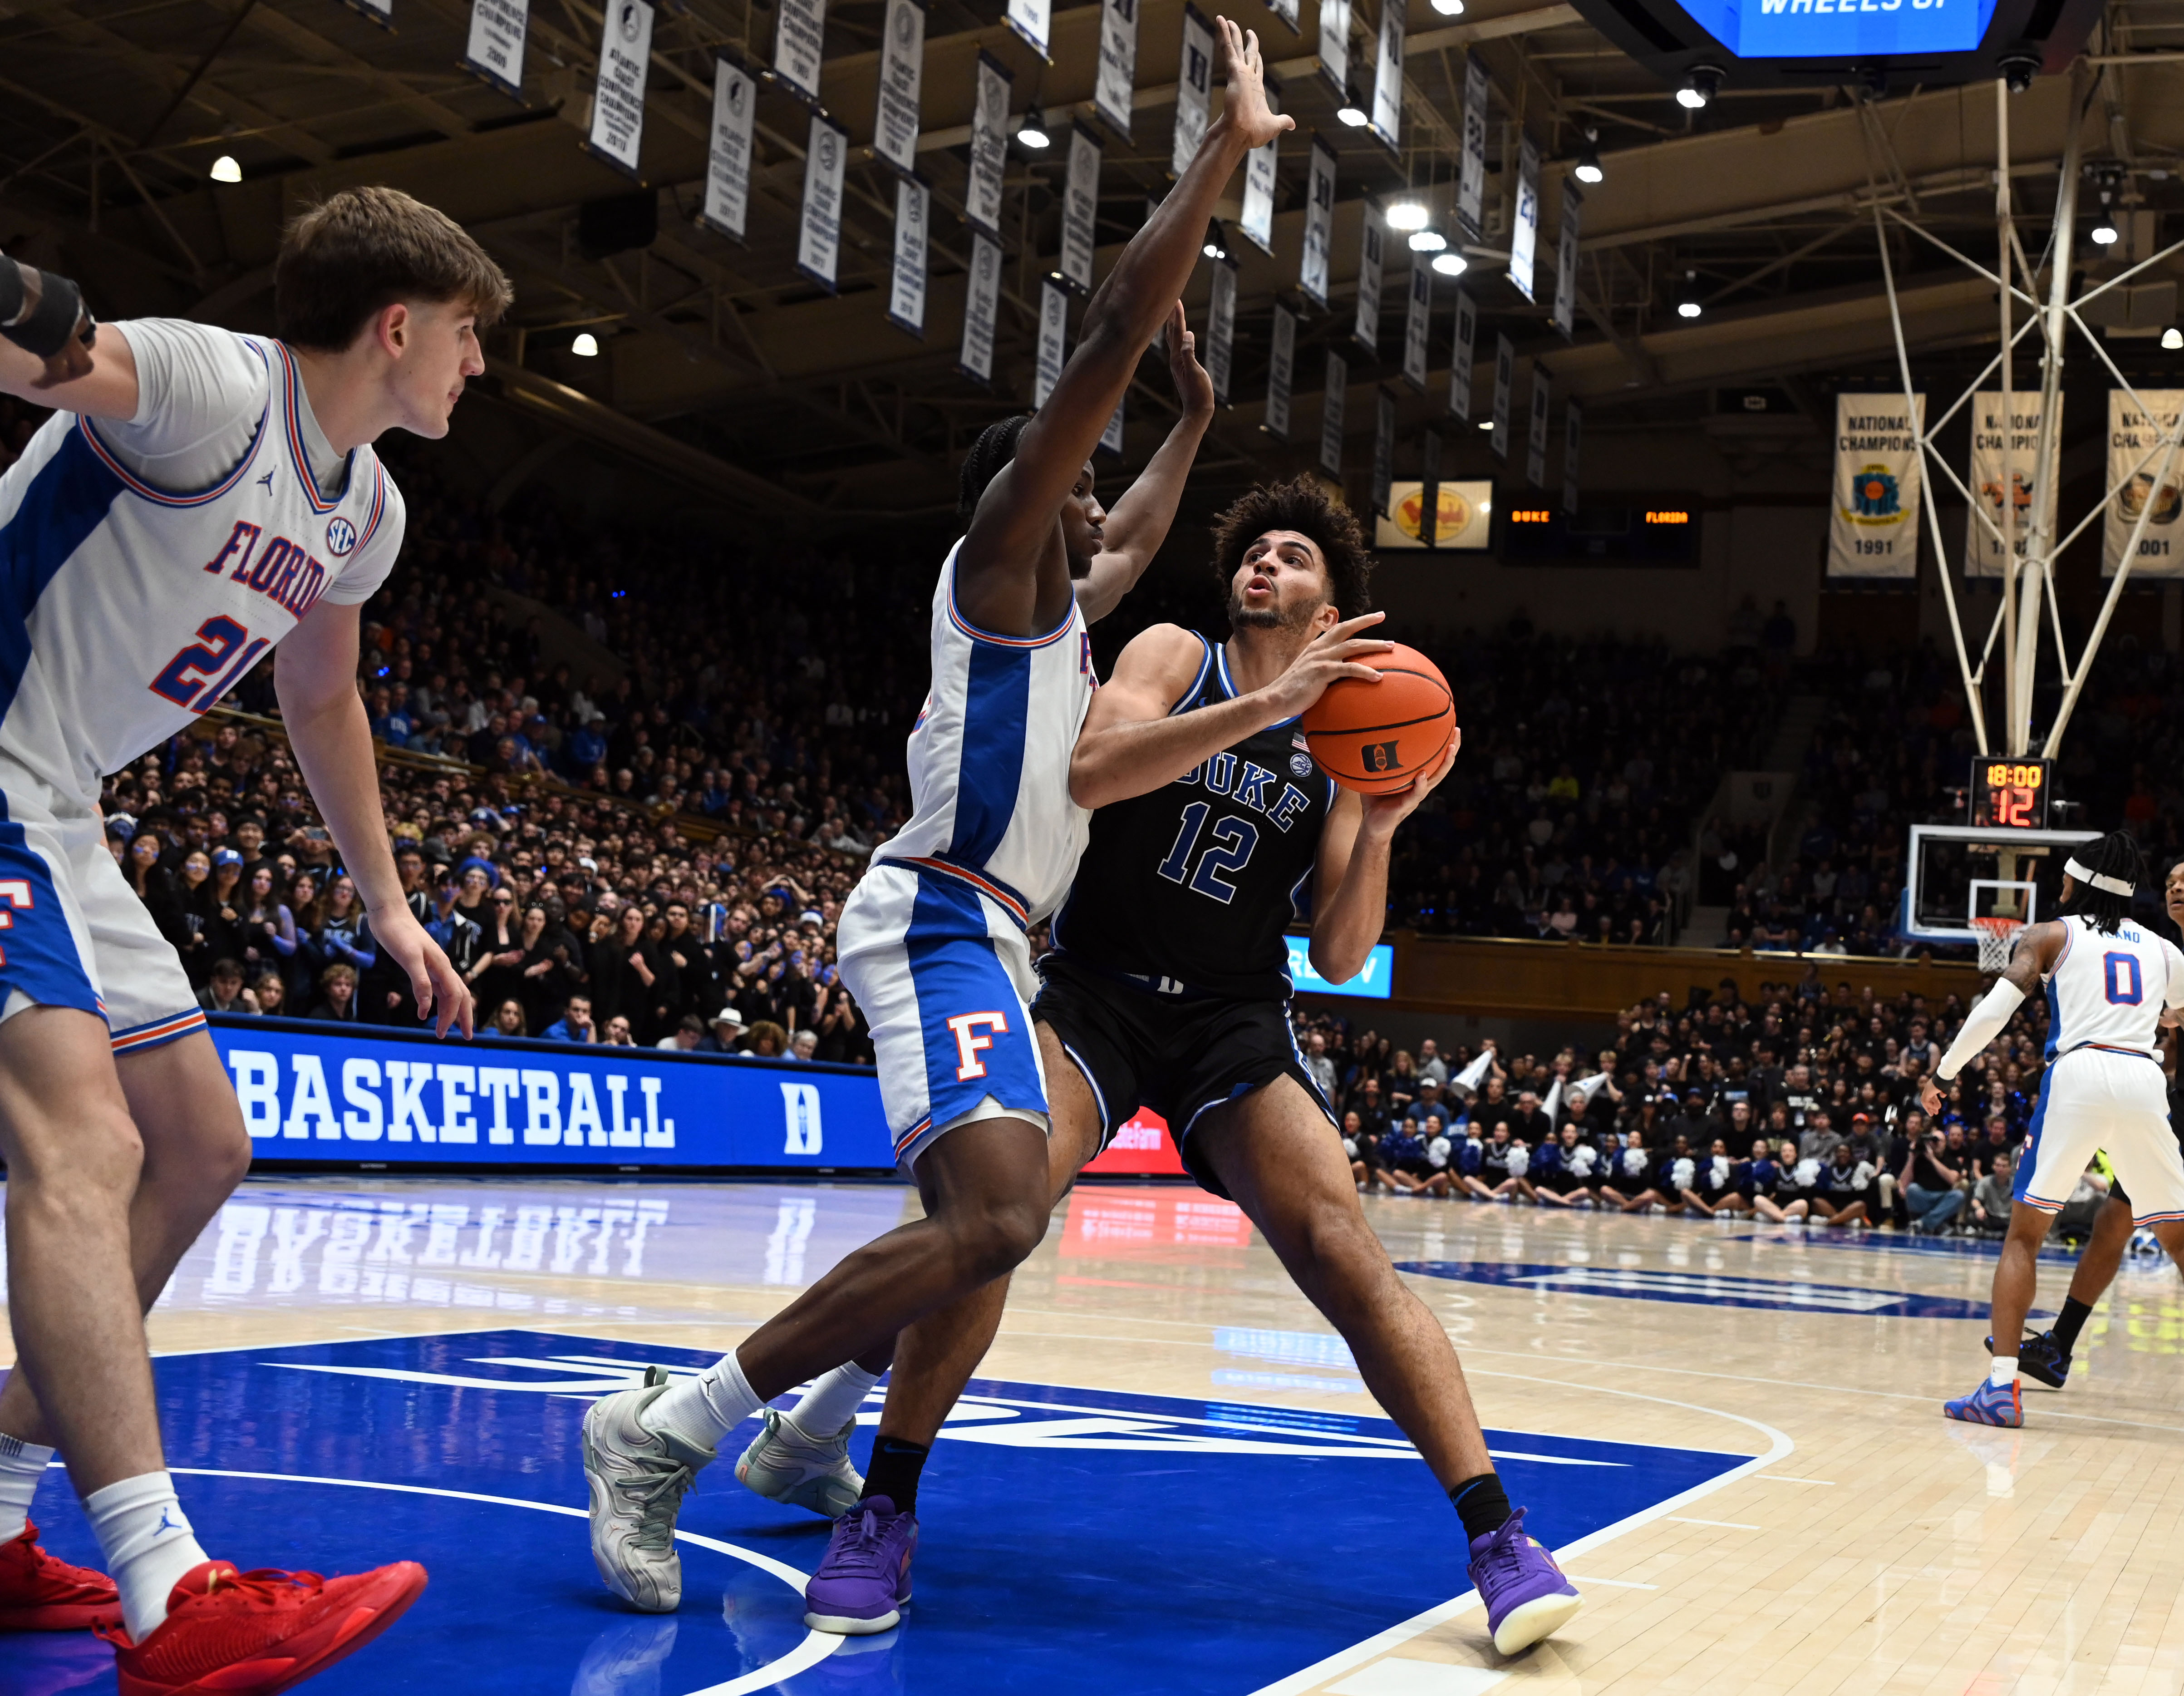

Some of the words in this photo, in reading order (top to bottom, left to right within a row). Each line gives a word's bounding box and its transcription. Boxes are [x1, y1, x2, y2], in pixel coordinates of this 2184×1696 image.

[1840, 436, 1916, 451] CHAMPIONS
[1512, 510, 1549, 523] DUKE
[1646, 511, 1688, 523] FLORIDA
[329, 519, 354, 554] SEC
[1855, 539, 1892, 555] 1991
[2135, 538, 2169, 556] 001
[204, 520, 333, 623] FLORID
[149, 615, 270, 715] 21
[1987, 764, 2041, 787] 18:00
[1999, 789, 2033, 826] 12
[1157, 801, 1259, 904] 12
[2103, 951, 2143, 1006] 0
[947, 1011, 1009, 1083] F
[229, 1050, 675, 1149] BASKETBALL
[780, 1083, 822, 1154] D
